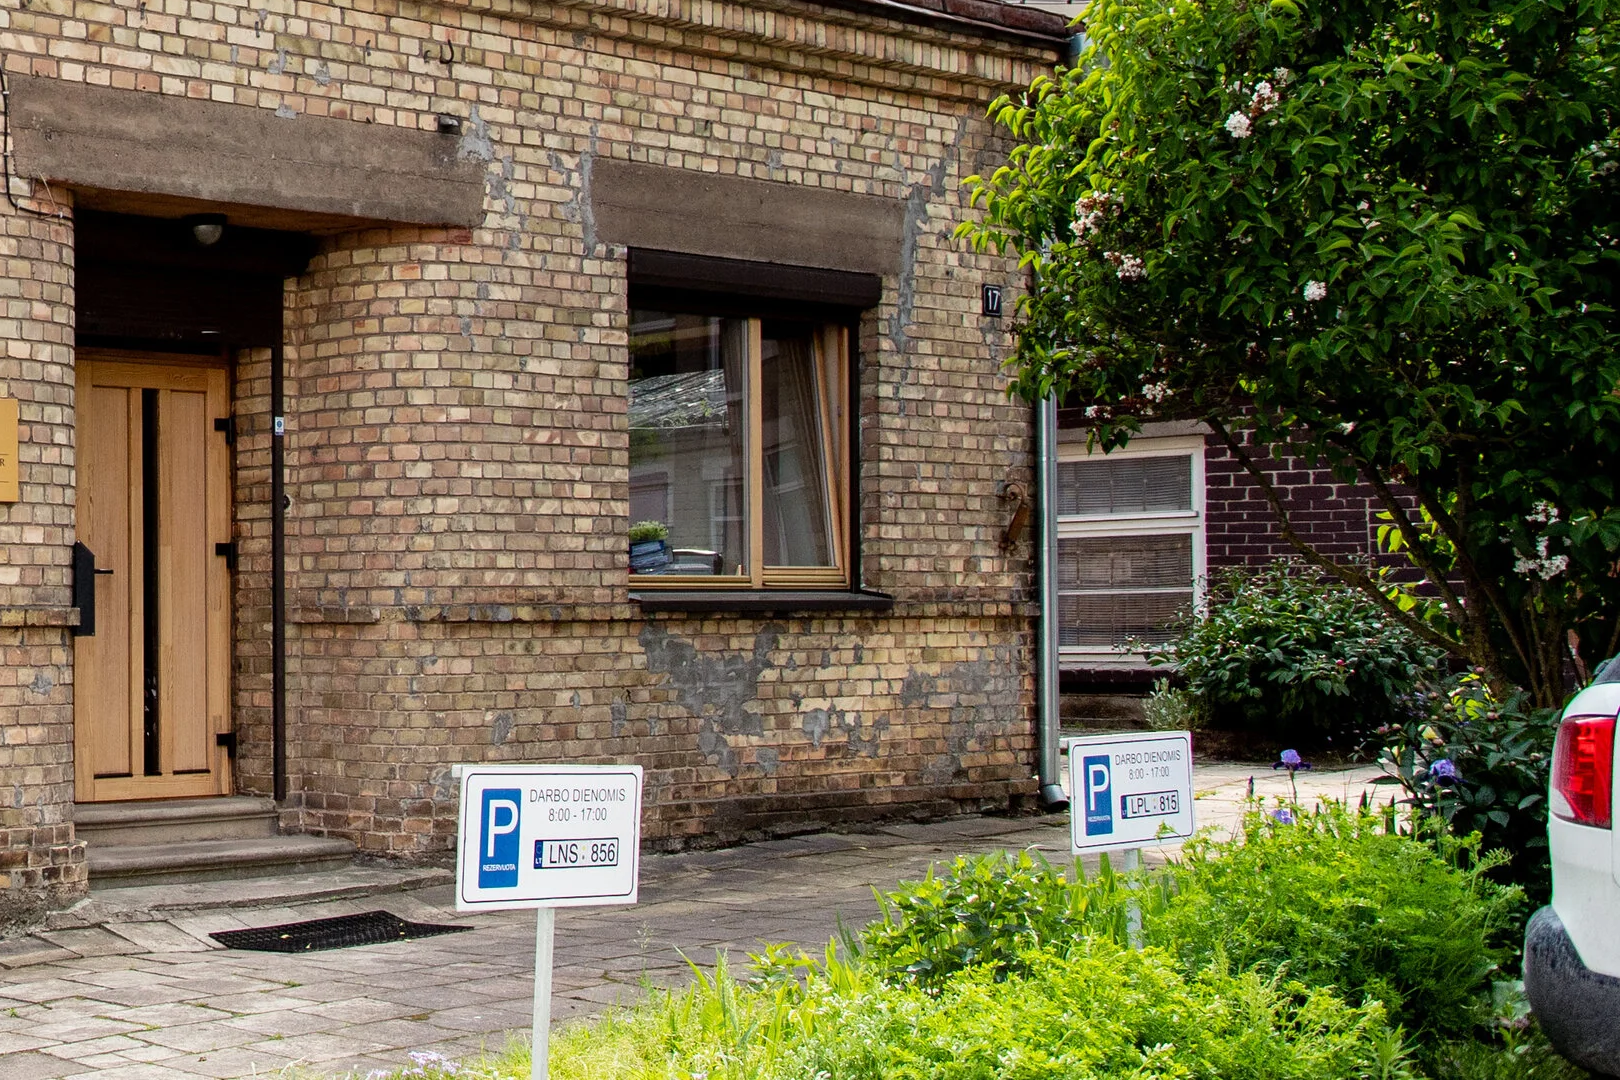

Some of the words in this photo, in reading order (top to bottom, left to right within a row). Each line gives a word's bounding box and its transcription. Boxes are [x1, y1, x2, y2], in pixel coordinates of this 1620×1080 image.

[988, 289, 1000, 311] 17
[1115, 753, 1143, 766] DARBO
[1144, 749, 1181, 763] DIENOMIS
[1128, 768, 1145, 780] 8:00
[1151, 766, 1169, 778] 17:00
[529, 788, 570, 803] DARBO
[572, 788, 626, 802] DIENOMIS
[1088, 763, 1110, 811] P
[1131, 797, 1150, 814] LPL
[1159, 795, 1176, 811] 815
[548, 808, 571, 822] 8:00
[580, 807, 608, 821] 17:00
[487, 799, 519, 858] P
[549, 843, 579, 864] LNS
[590, 842, 616, 862] 856
